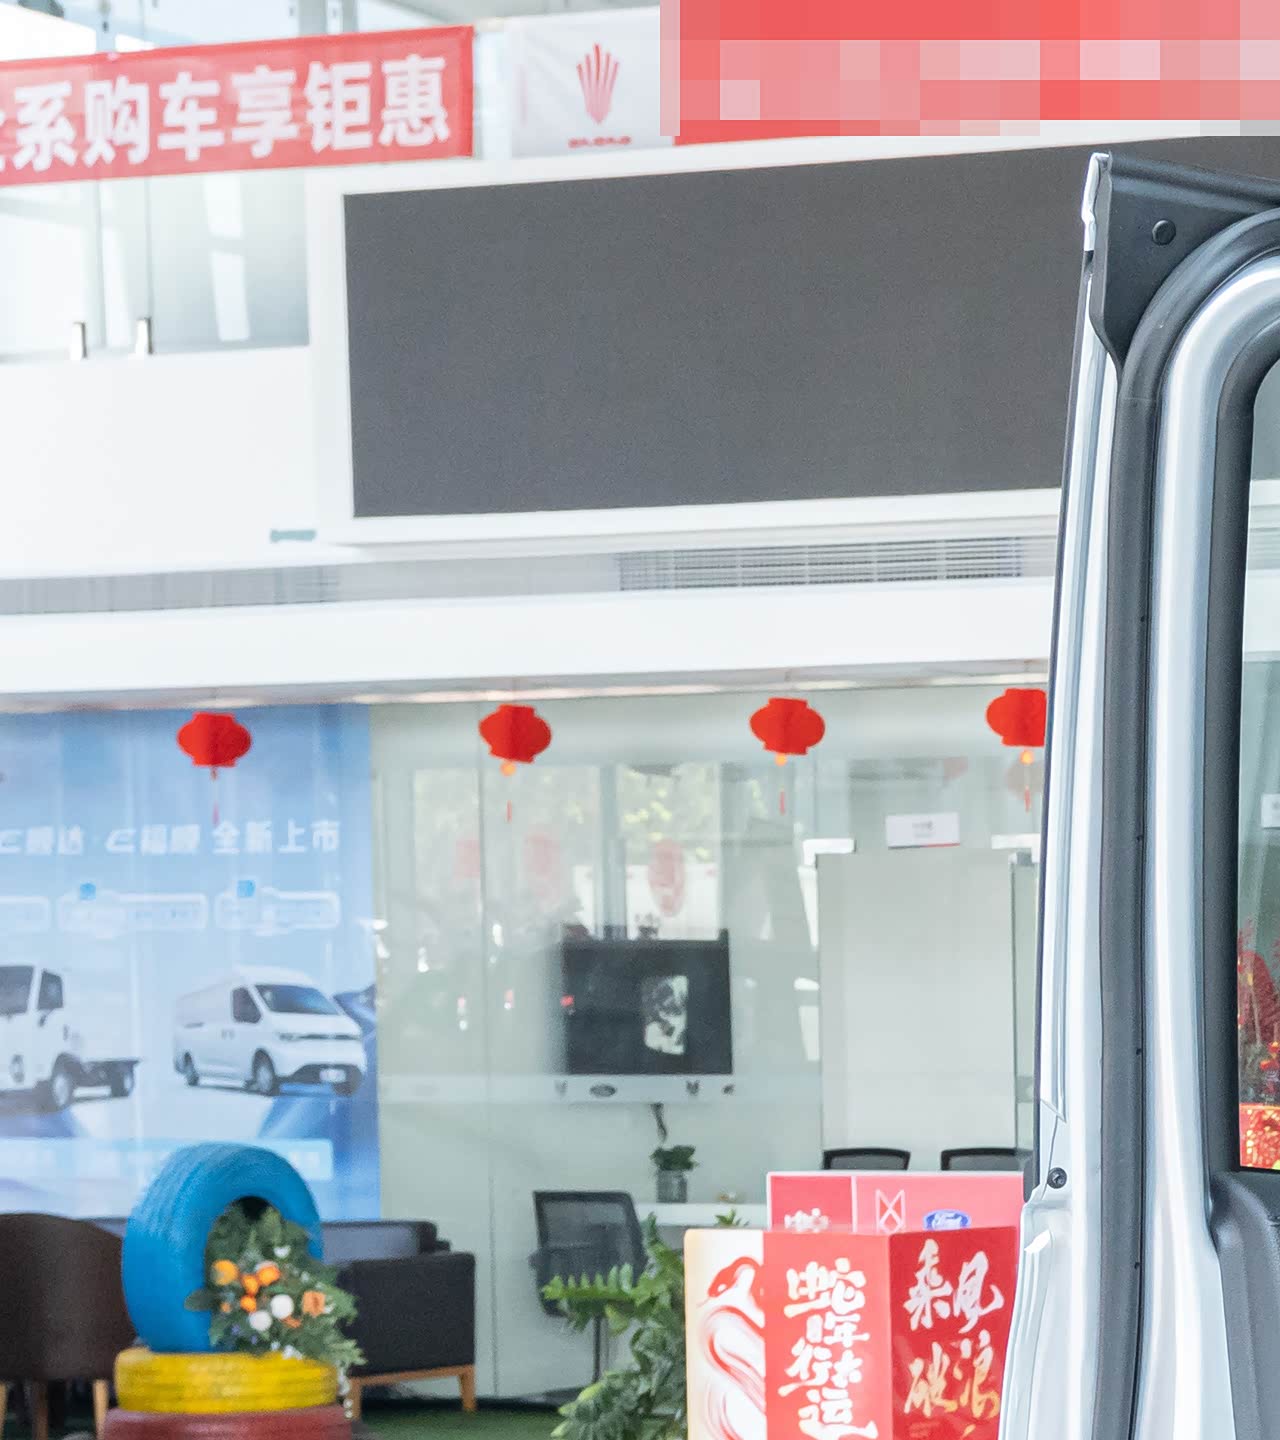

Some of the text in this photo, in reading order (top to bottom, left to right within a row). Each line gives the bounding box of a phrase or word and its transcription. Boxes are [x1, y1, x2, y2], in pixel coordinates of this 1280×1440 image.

[0, 54, 450, 172] 系购车享钜惠
